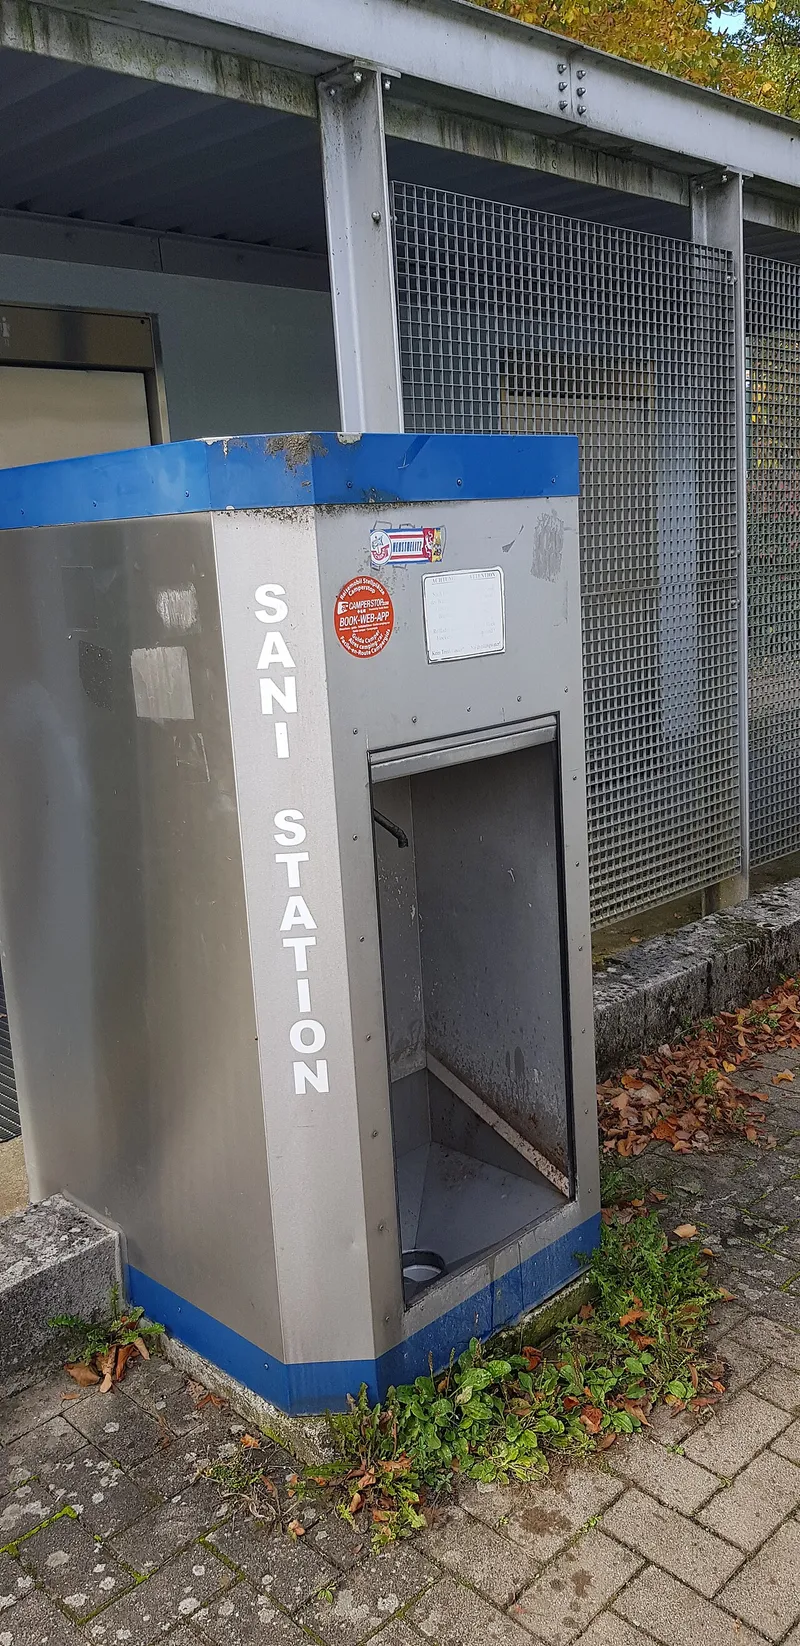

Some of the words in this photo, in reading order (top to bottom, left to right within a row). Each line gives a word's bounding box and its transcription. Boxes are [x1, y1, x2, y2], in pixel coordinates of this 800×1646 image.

[349, 585, 375, 596] Camperstop
[340, 611, 390, 627] BOOK-WEB-APP
[365, 630, 380, 644] Camper
[254, 583, 298, 759] SANI
[273, 808, 330, 1095] STATION
